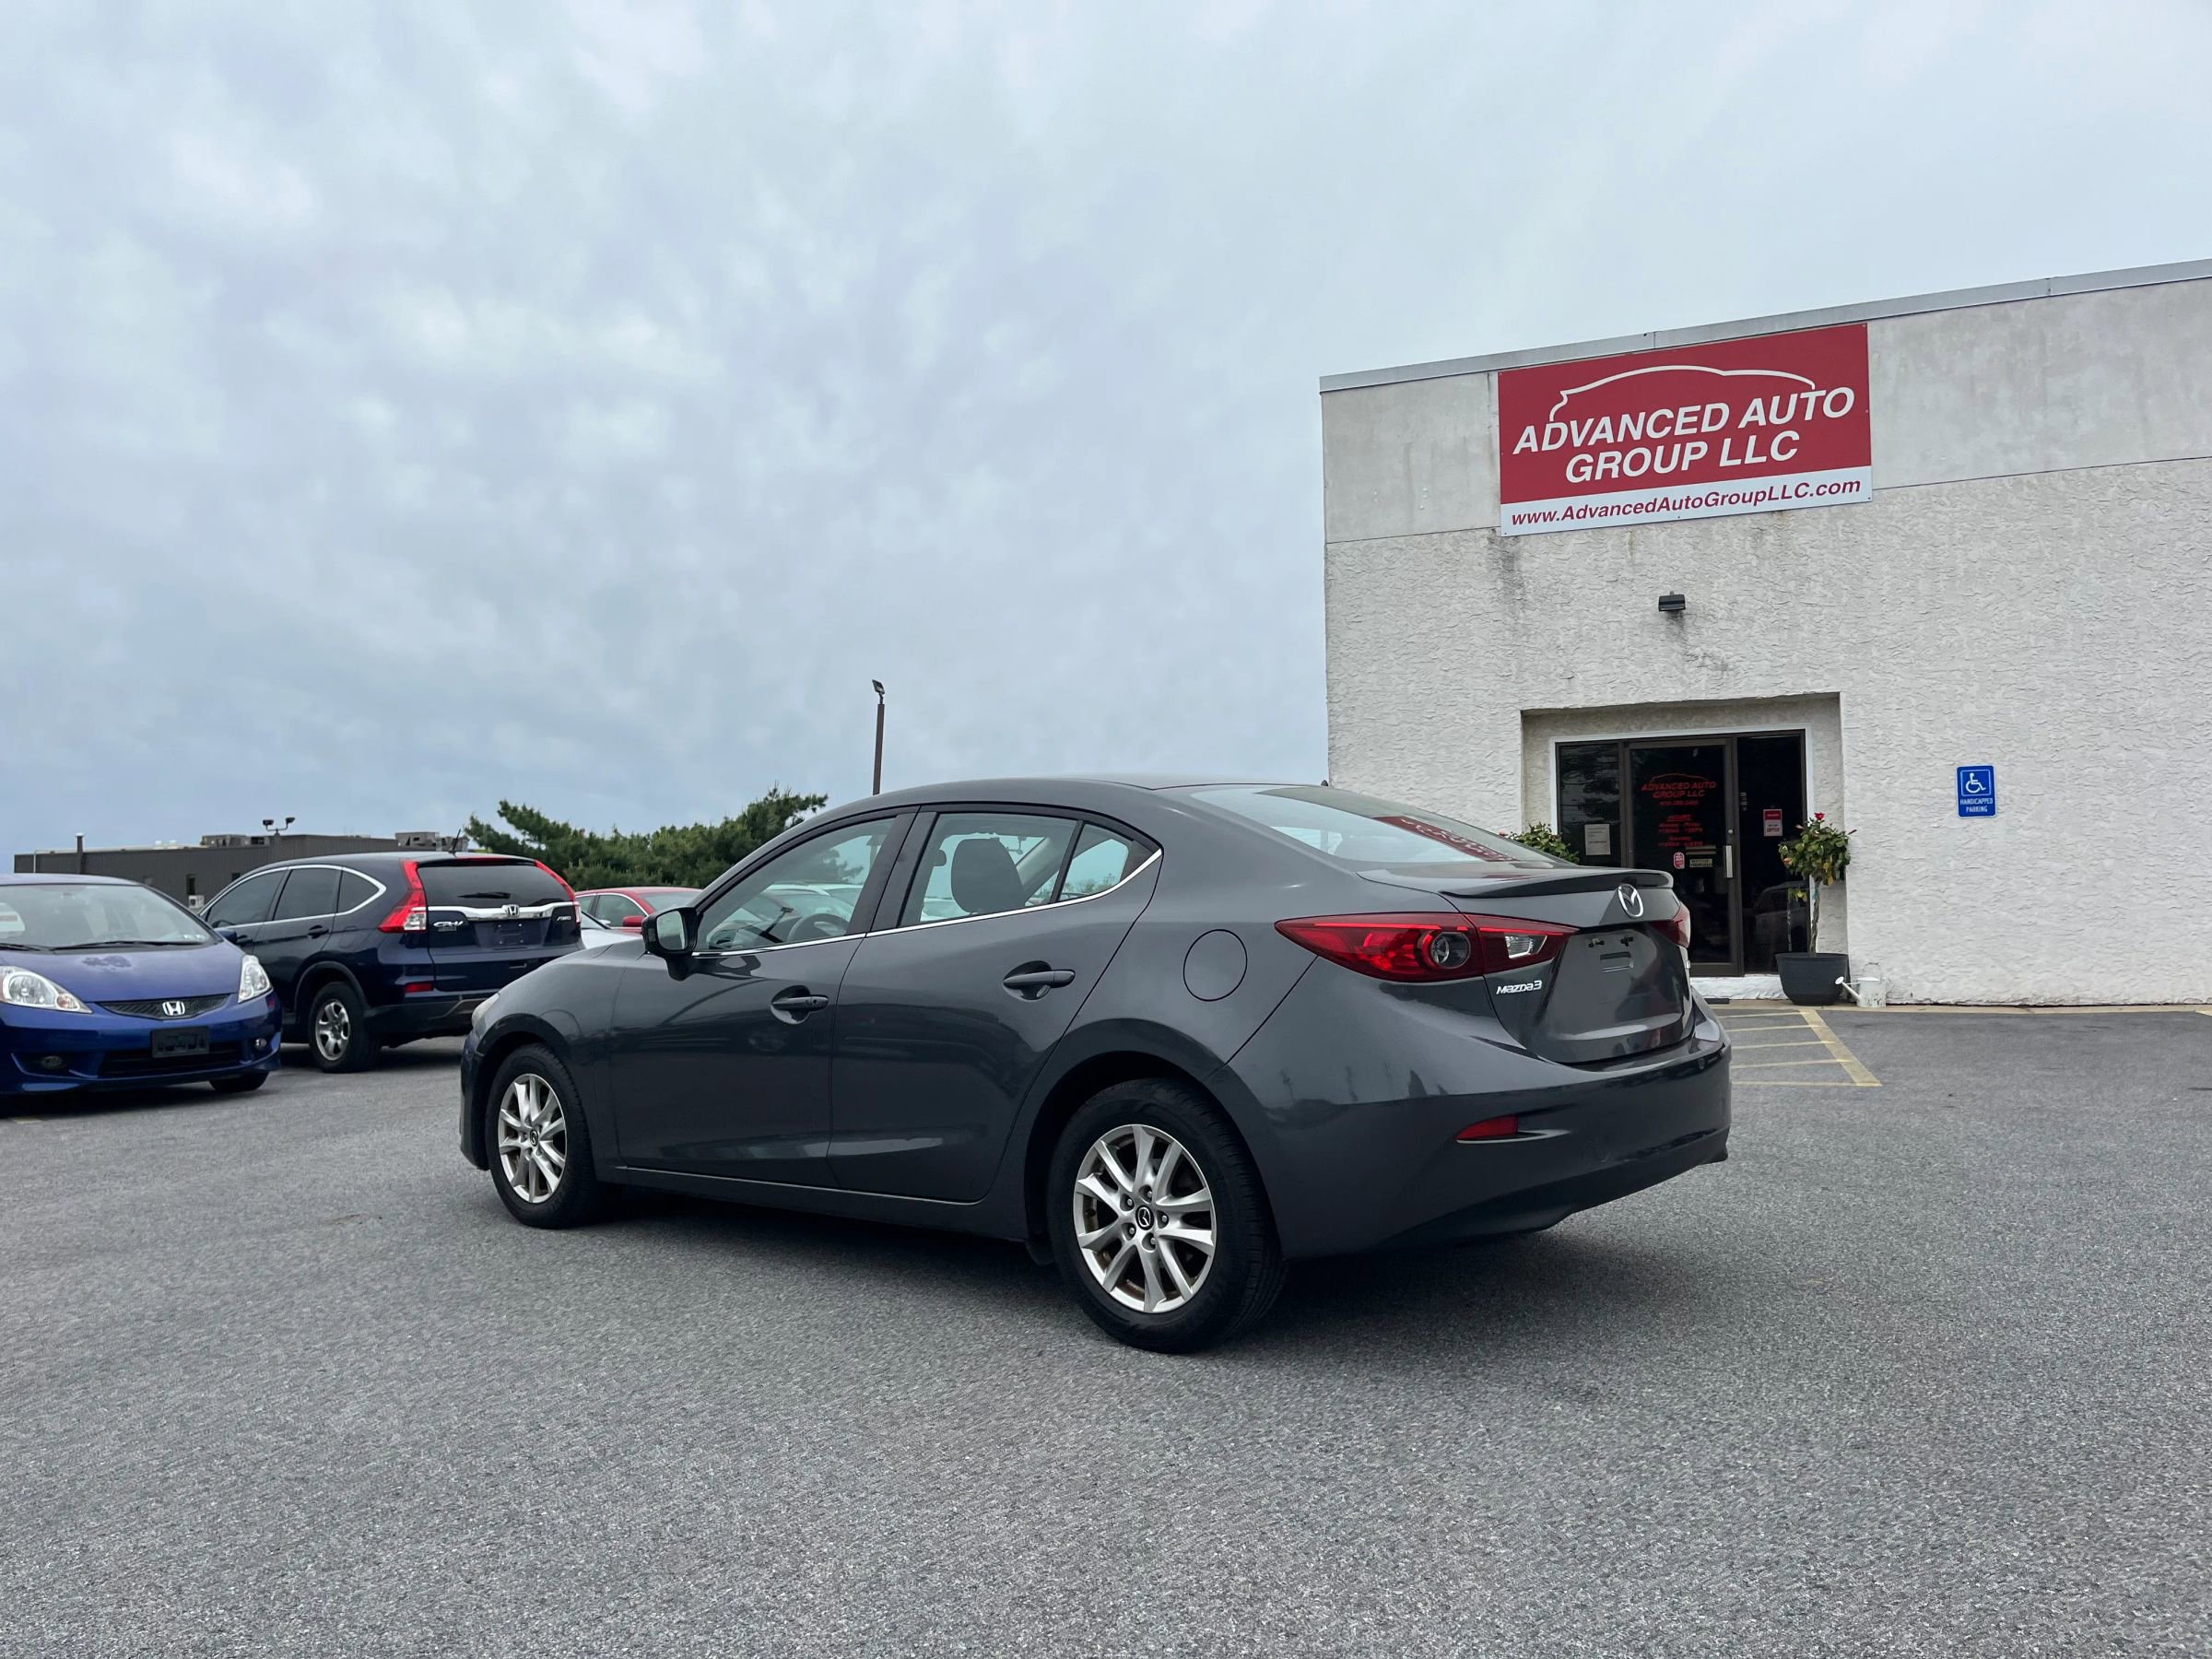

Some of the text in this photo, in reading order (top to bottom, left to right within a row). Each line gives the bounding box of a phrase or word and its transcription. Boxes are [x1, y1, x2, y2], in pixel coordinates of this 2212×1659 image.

[1512, 386, 1854, 455] ADVANCED AUTO
[1565, 430, 1800, 484] GROUP LLC
[1511, 479, 1861, 525] www.AdvancedAutoGroupLLC.com
[1641, 782, 1689, 791] ADVANCED
